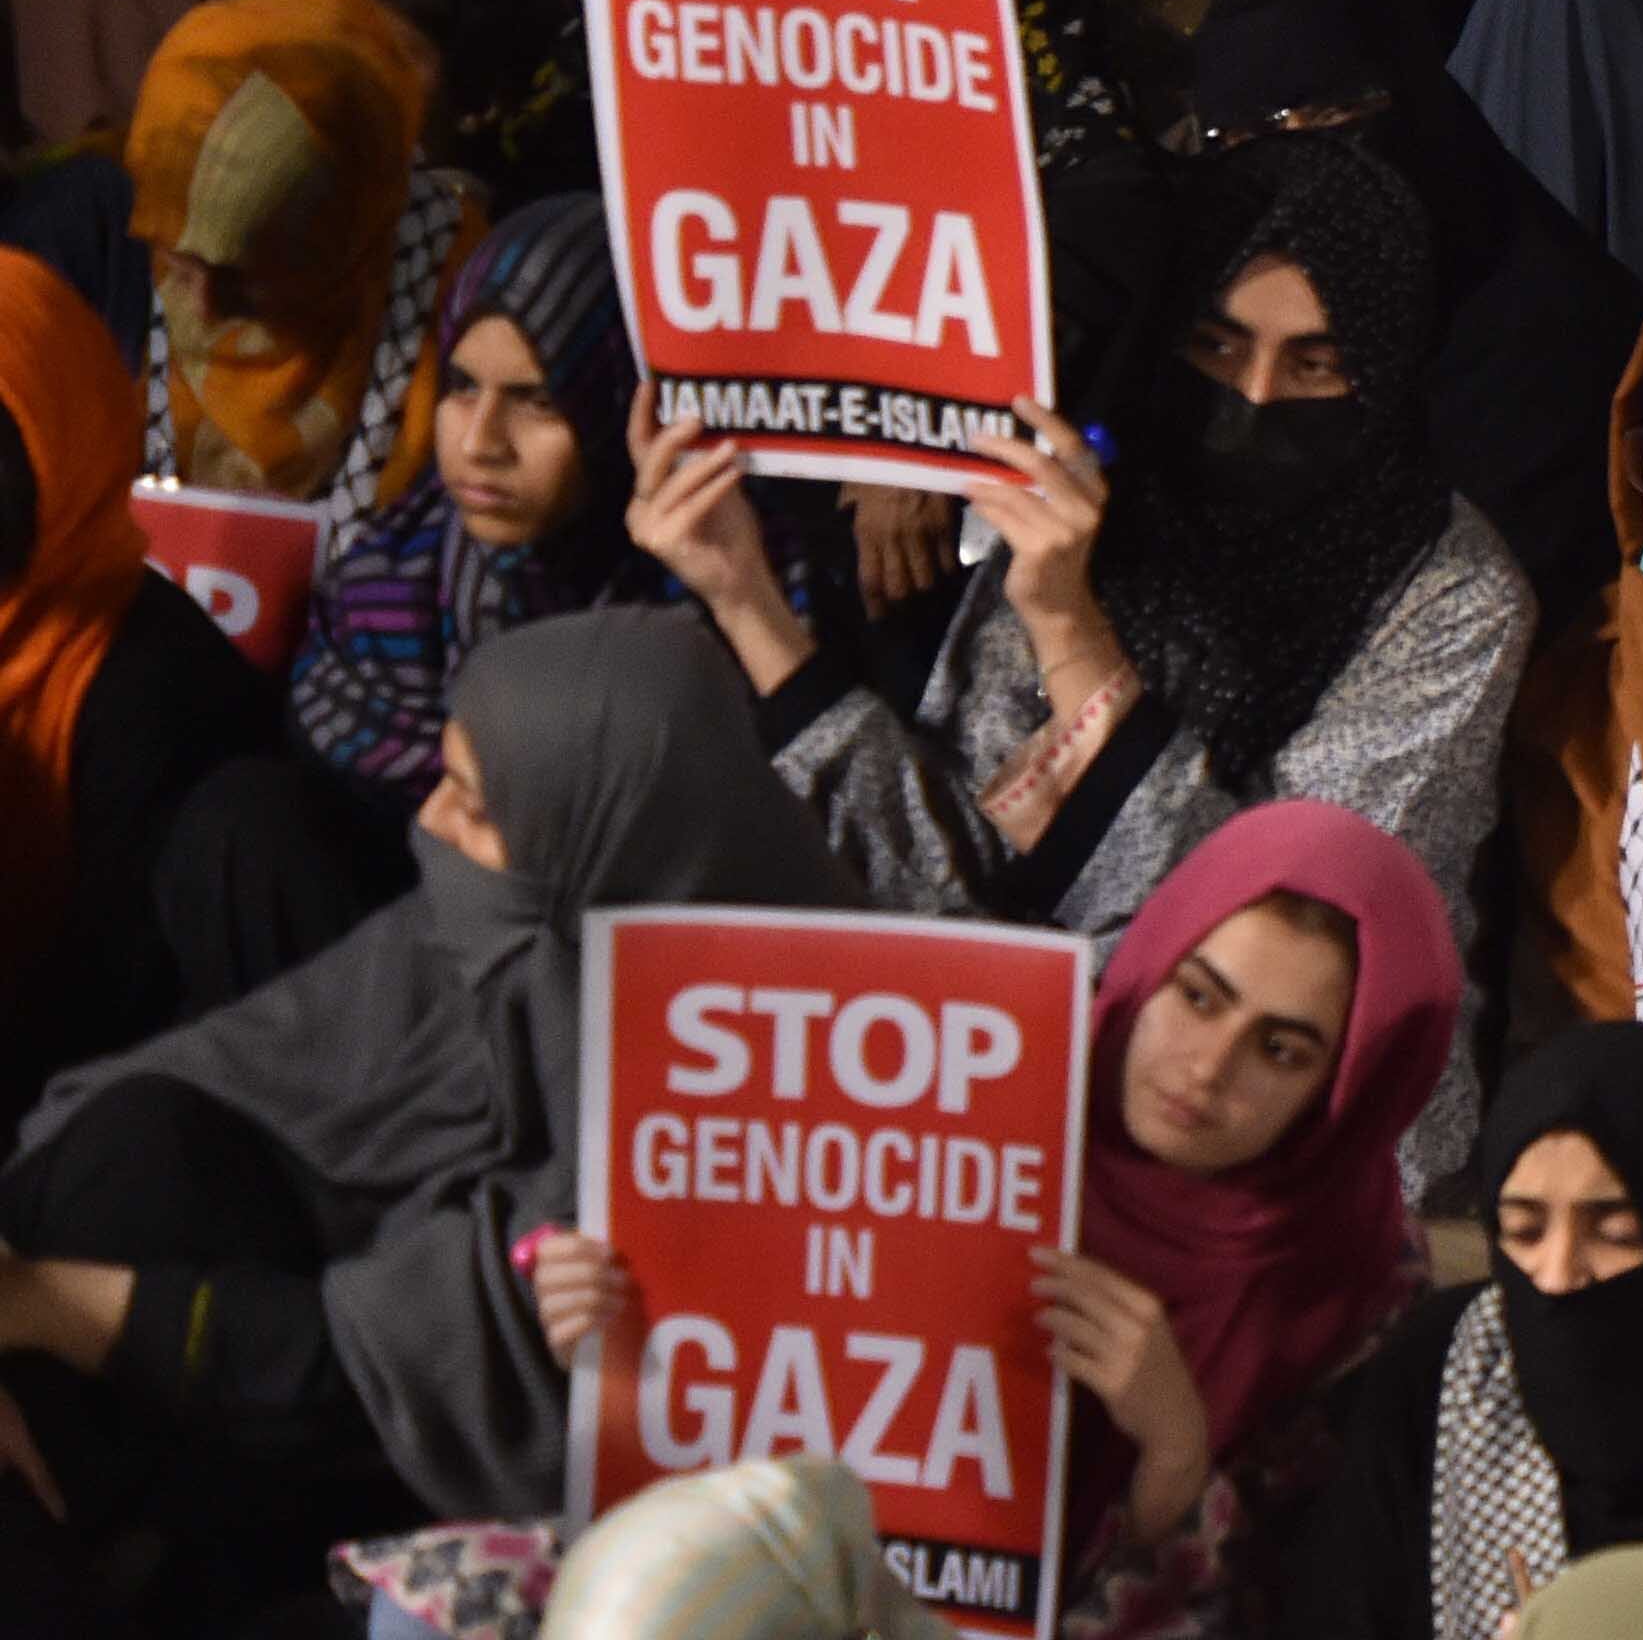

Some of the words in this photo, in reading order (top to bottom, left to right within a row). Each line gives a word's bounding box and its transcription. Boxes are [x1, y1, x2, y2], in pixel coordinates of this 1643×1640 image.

[789, 102, 856, 170] IN
[651, 189, 1000, 359] GAZA
[665, 981, 1023, 1114] STOP
[631, 1112, 1043, 1233] GENOCIDE
[804, 1225, 873, 1300] IN
[636, 1313, 1013, 1500] GAZA
